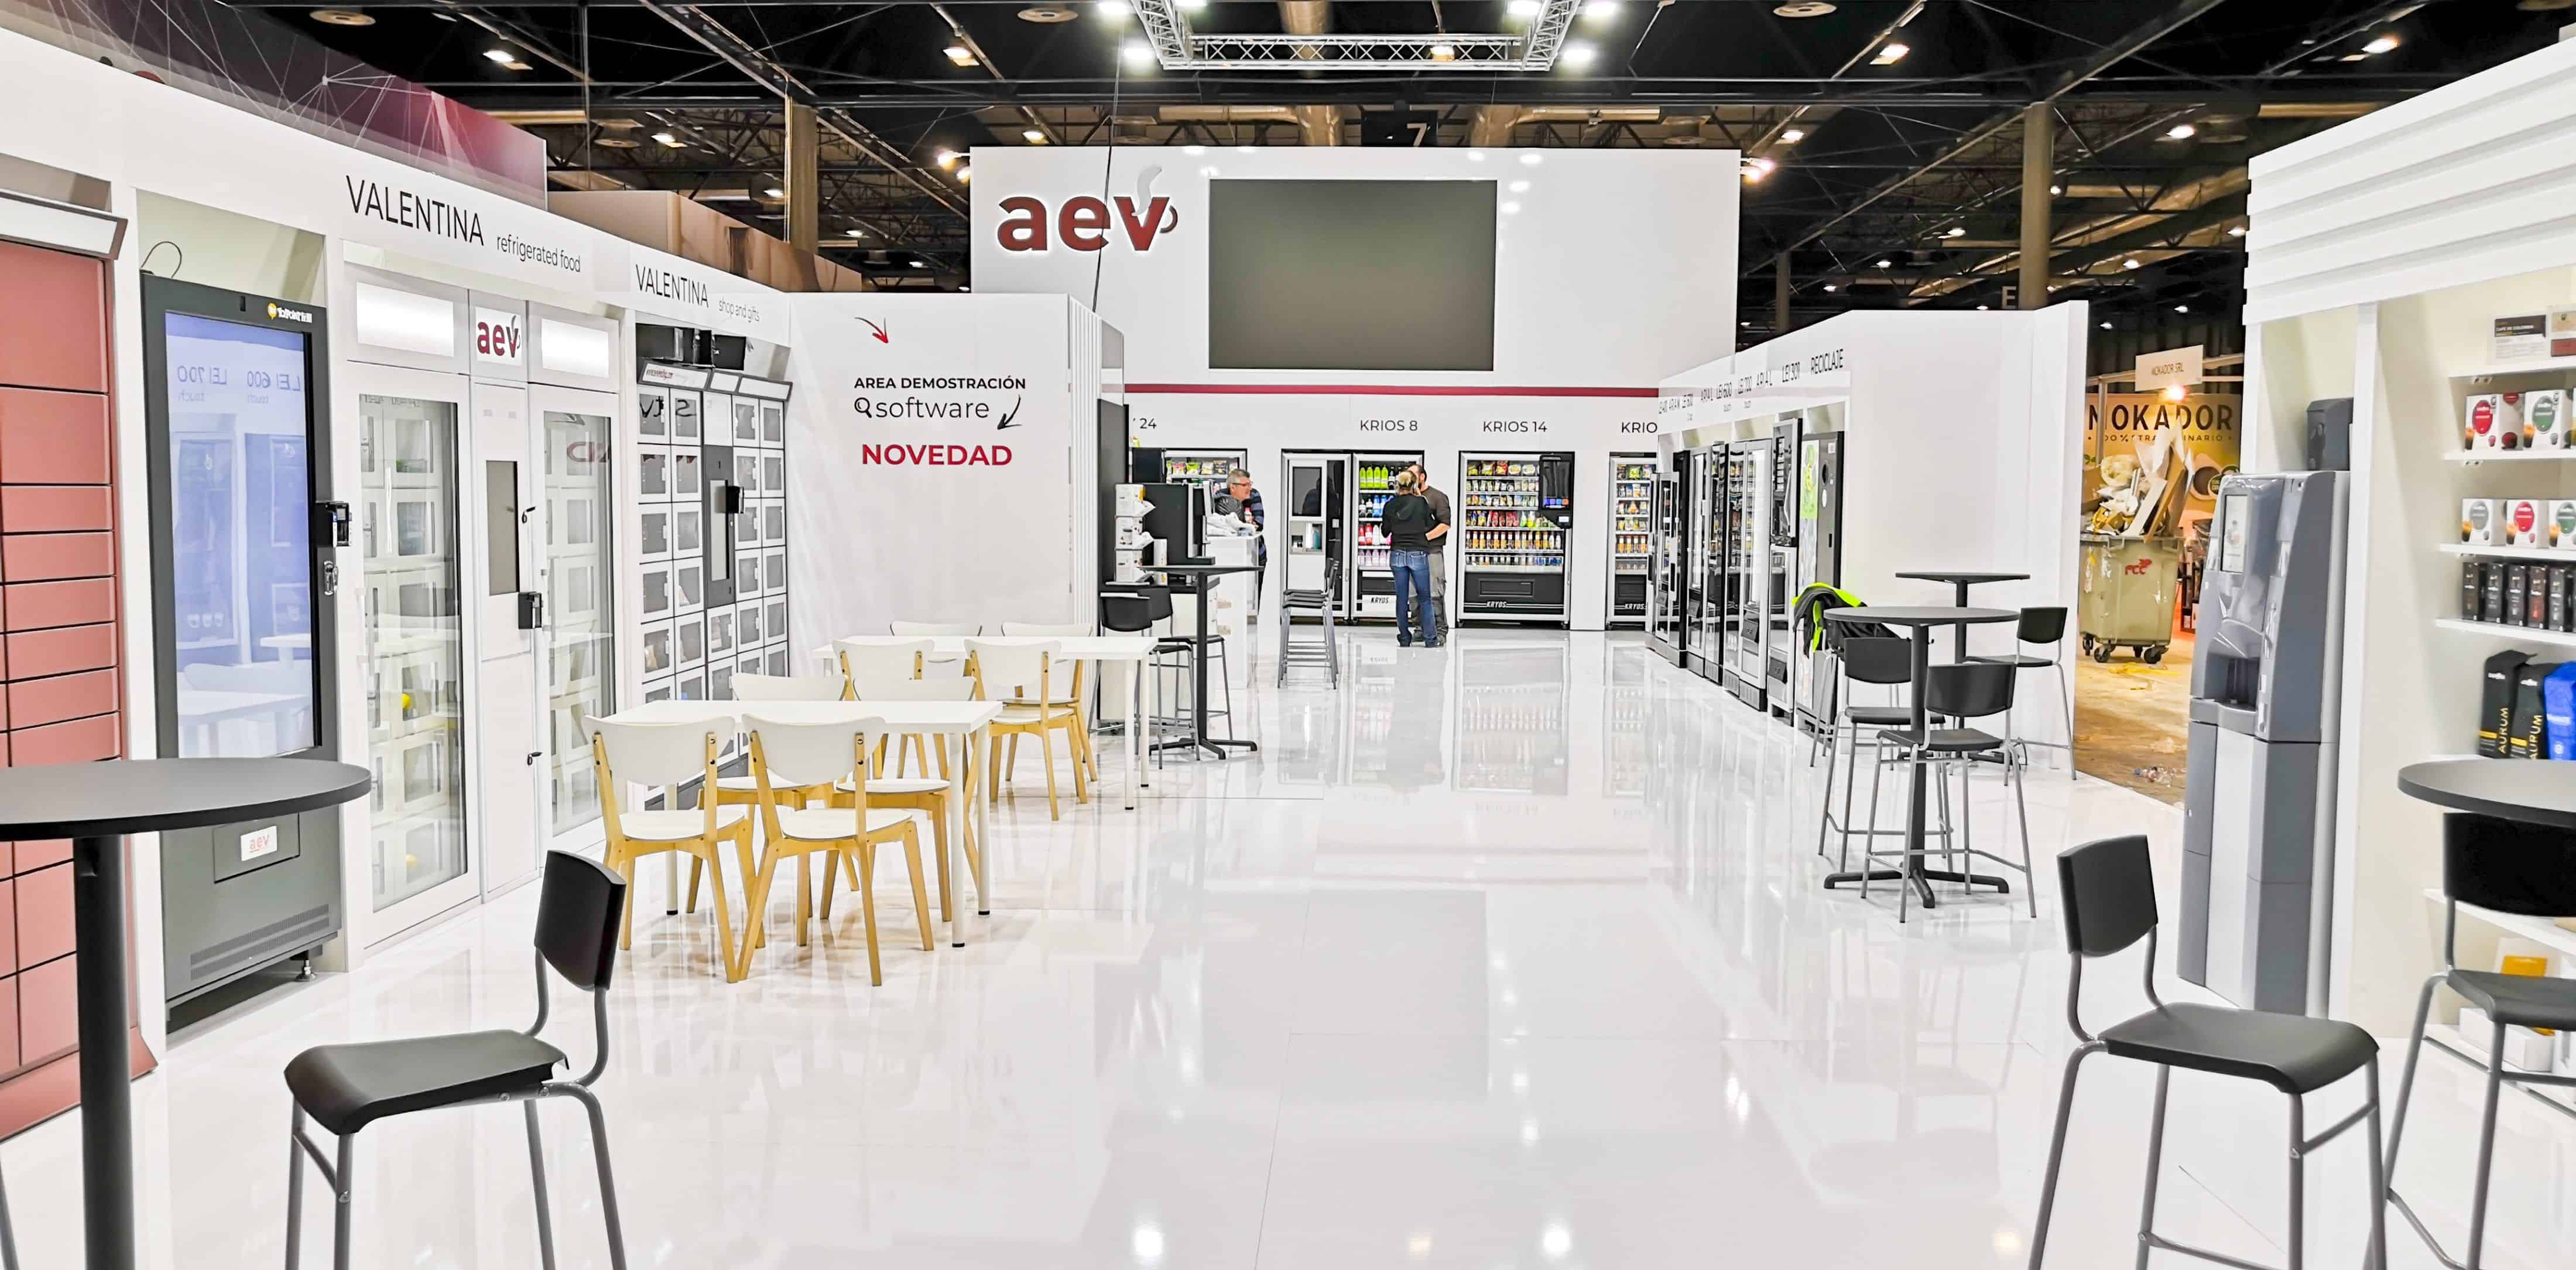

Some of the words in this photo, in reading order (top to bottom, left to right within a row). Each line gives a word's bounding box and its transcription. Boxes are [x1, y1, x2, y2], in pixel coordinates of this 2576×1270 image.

[346, 175, 484, 245] VALENTINA
[496, 235, 557, 266] refrigerated
[560, 250, 580, 272] food
[997, 196, 1177, 251] aev
[636, 264, 708, 308] VALENTINA
[719, 297, 734, 318] shop
[735, 304, 746, 318] and
[2002, 286, 2016, 309] E
[477, 321, 520, 357] aev
[1811, 348, 1844, 375] RECICLAJE
[854, 378, 896, 389] AREA
[901, 375, 1026, 389] DEMOSTRACIÓN
[876, 396, 989, 418] software
[1139, 417, 1157, 429] 24
[1360, 420, 1406, 432] KRIOS
[1409, 420, 1418, 432] 8
[1483, 421, 1529, 433] KRIOS
[1532, 421, 1547, 433] 14
[862, 444, 1012, 465] NOVEDAD
[2498, 707, 2509, 754] AURUM
